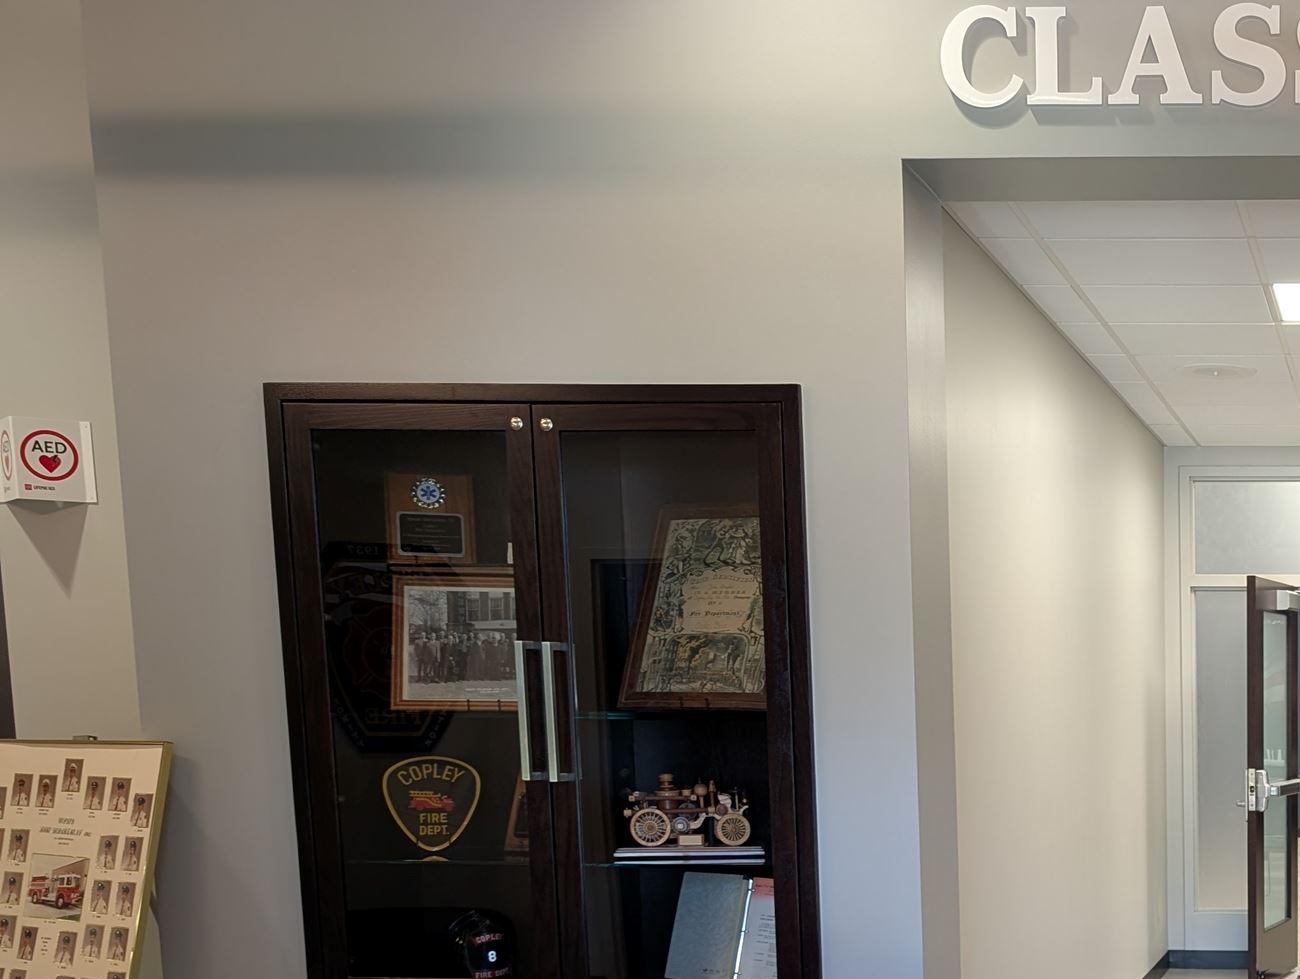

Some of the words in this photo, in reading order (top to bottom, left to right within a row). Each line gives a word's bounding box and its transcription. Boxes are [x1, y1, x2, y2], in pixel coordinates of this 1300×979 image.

[31, 440, 67, 454] AED
[397, 763, 465, 785] COPLEY
[420, 813, 448, 824] FIRE
[419, 825, 450, 836] DEPT.
[488, 951, 497, 962] 8
